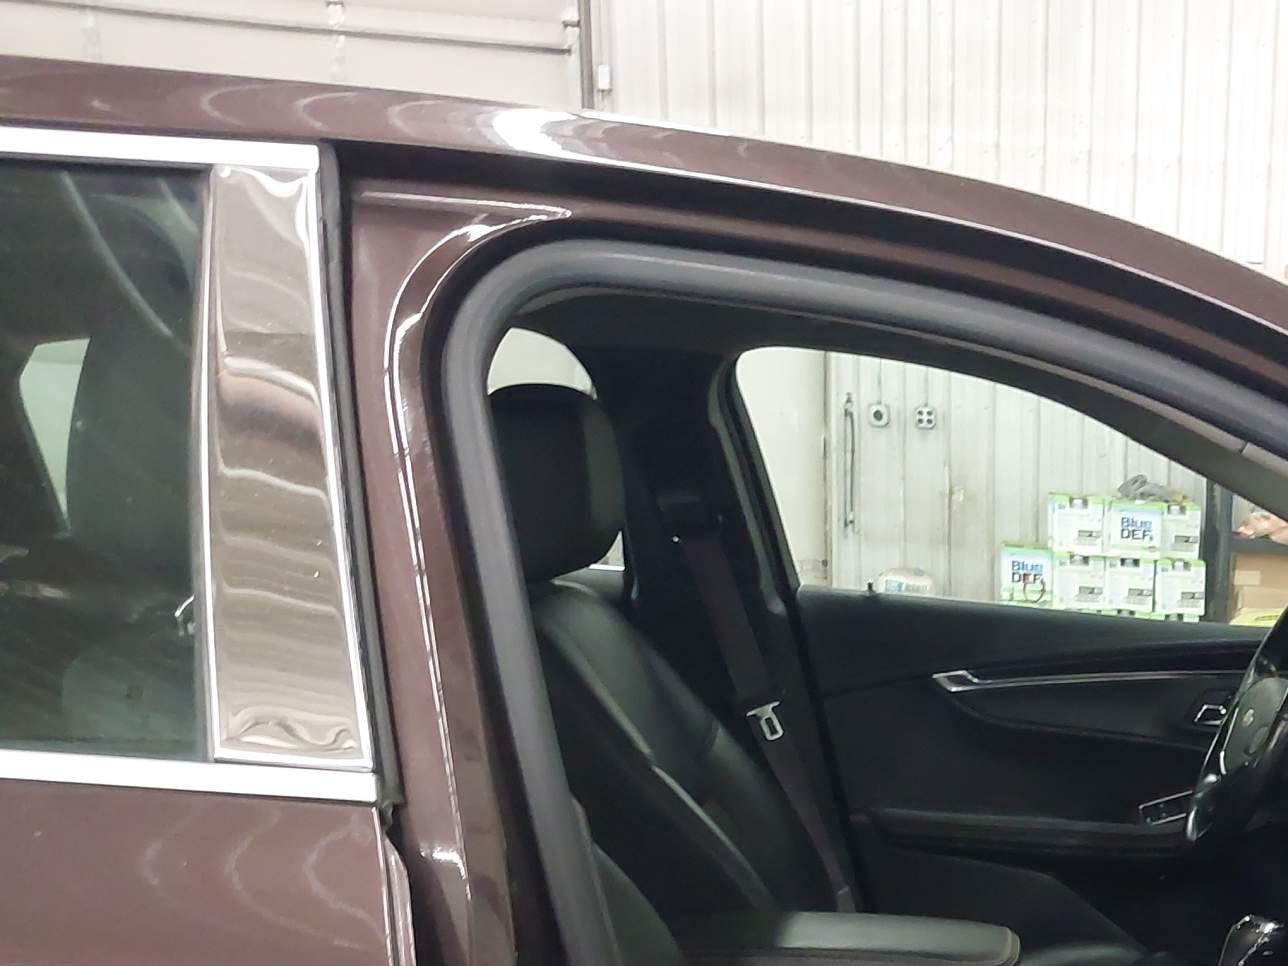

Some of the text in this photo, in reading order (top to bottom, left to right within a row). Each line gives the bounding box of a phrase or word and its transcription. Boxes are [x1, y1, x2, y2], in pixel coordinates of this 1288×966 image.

[1121, 516, 1152, 529] Blue
[1120, 529, 1152, 541] DEF
[1011, 560, 1043, 572] Blue
[1011, 572, 1043, 584] DEF
